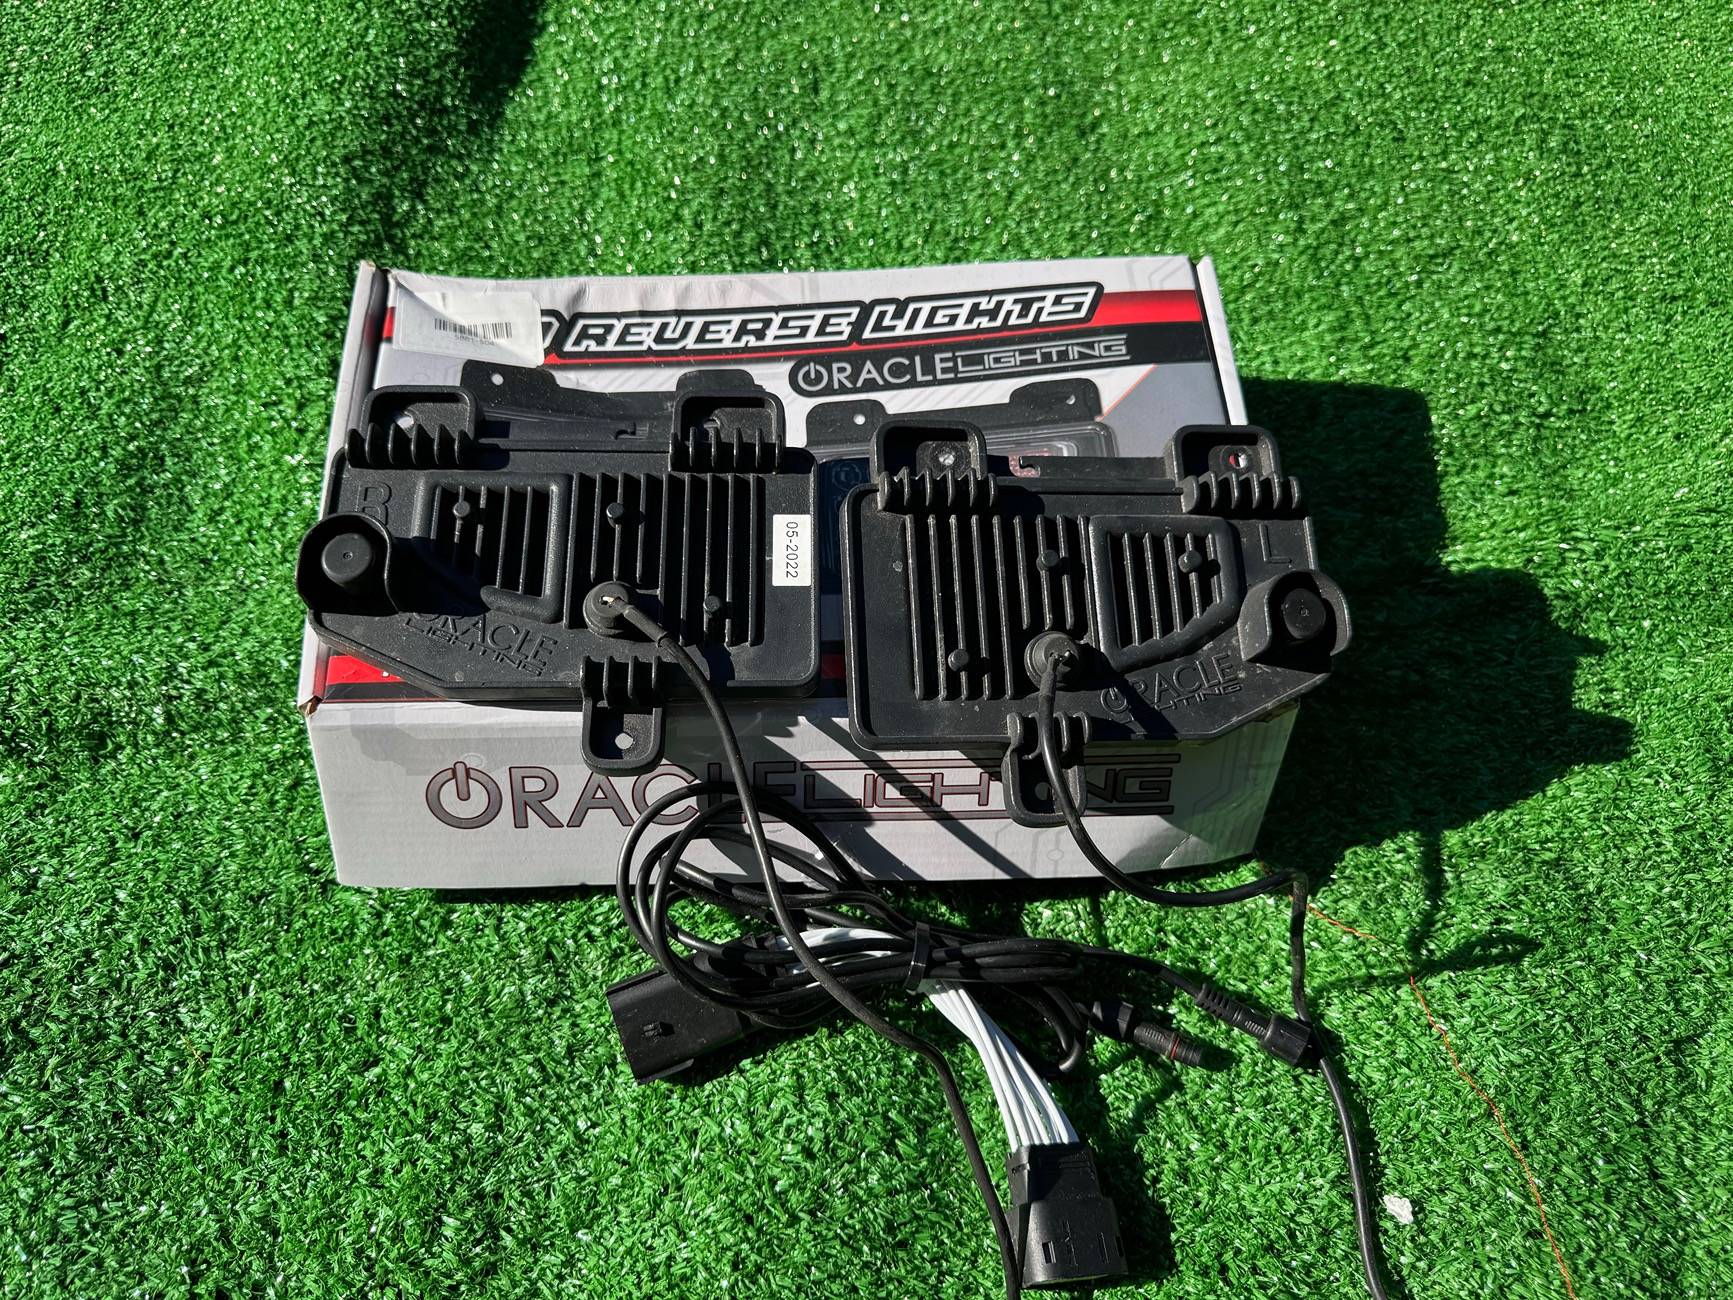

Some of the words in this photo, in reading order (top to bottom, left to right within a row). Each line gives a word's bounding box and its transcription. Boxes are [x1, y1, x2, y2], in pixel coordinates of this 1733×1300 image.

[563, 307, 861, 352] REVERSE
[861, 283, 1101, 340] LIGHTS
[797, 351, 955, 392] ORACLE
[956, 337, 1128, 373] LIGHTING
[786, 521, 799, 579] 05-2022
[804, 766, 1174, 812] LIGHNG
